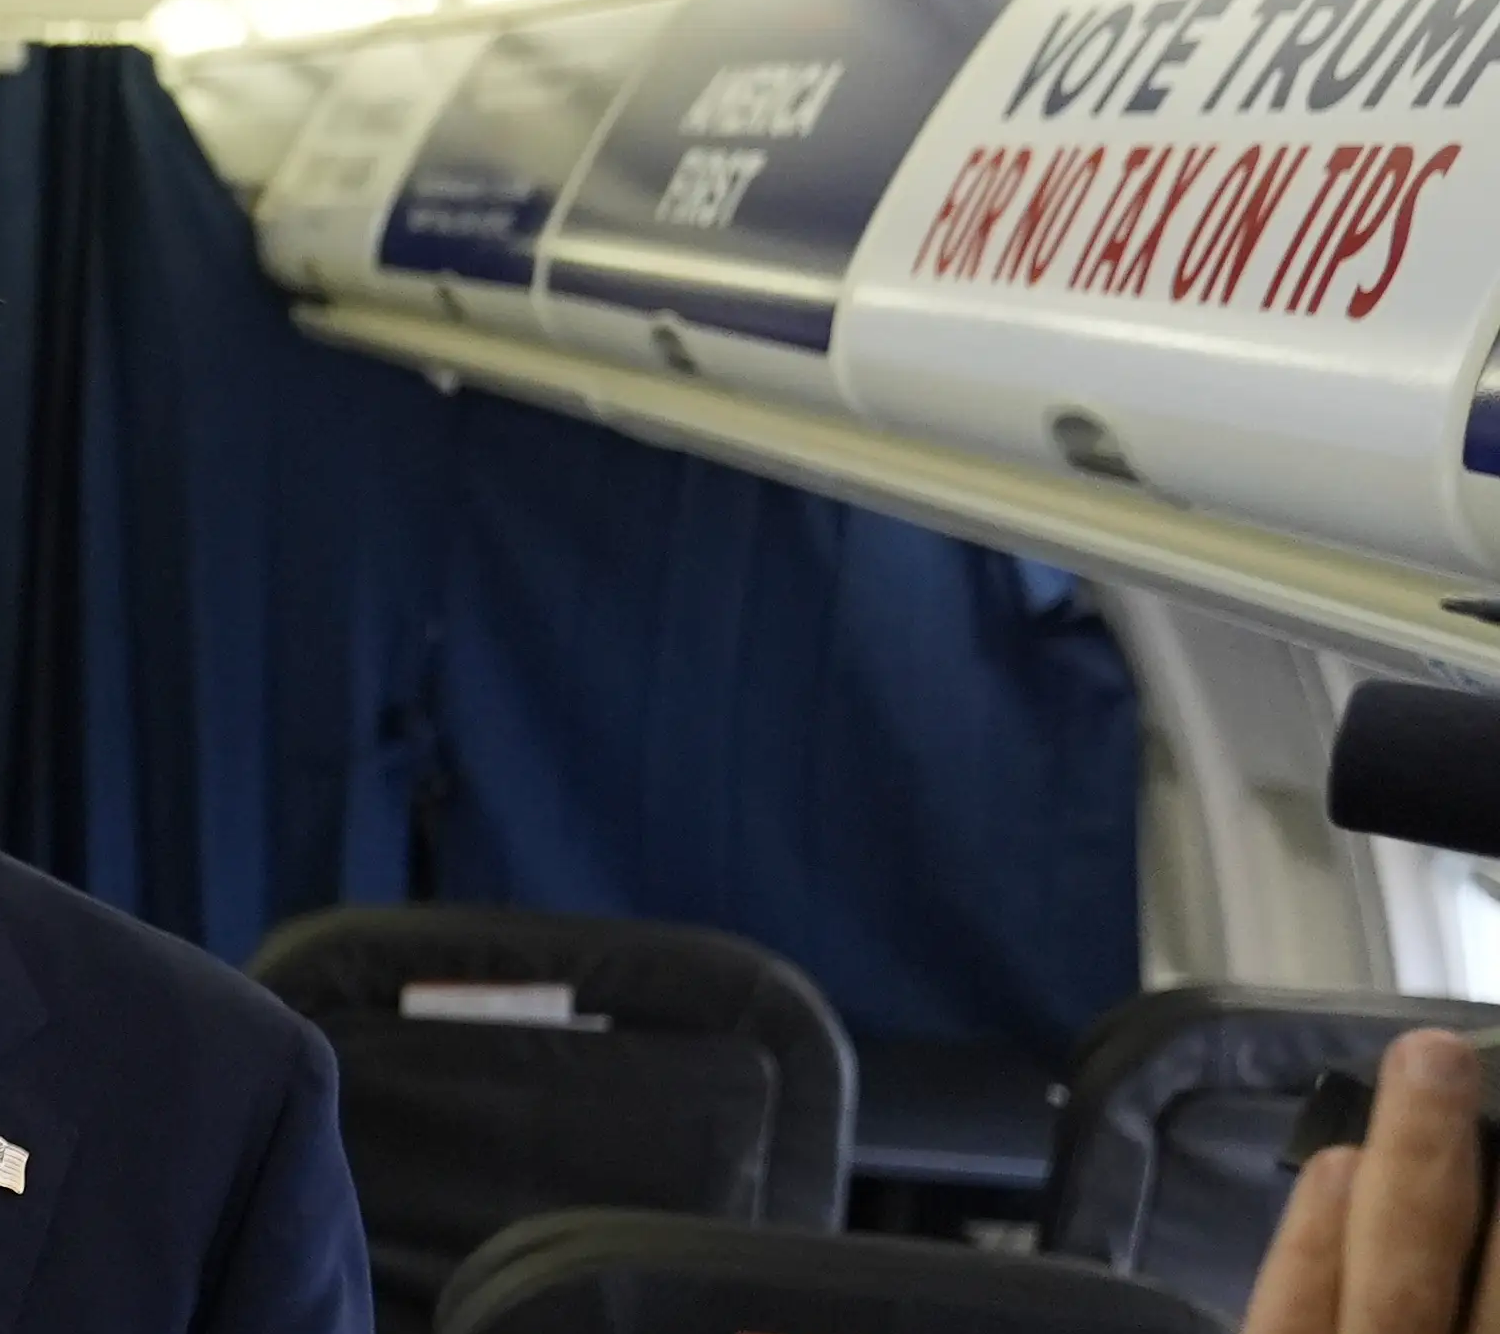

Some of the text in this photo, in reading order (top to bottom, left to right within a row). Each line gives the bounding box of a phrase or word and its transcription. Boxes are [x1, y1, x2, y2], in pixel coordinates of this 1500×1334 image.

[679, 60, 847, 137] AMERICA
[653, 147, 769, 229] FIRST
[911, 143, 1463, 322] FOR NO TAX ON TIPS
